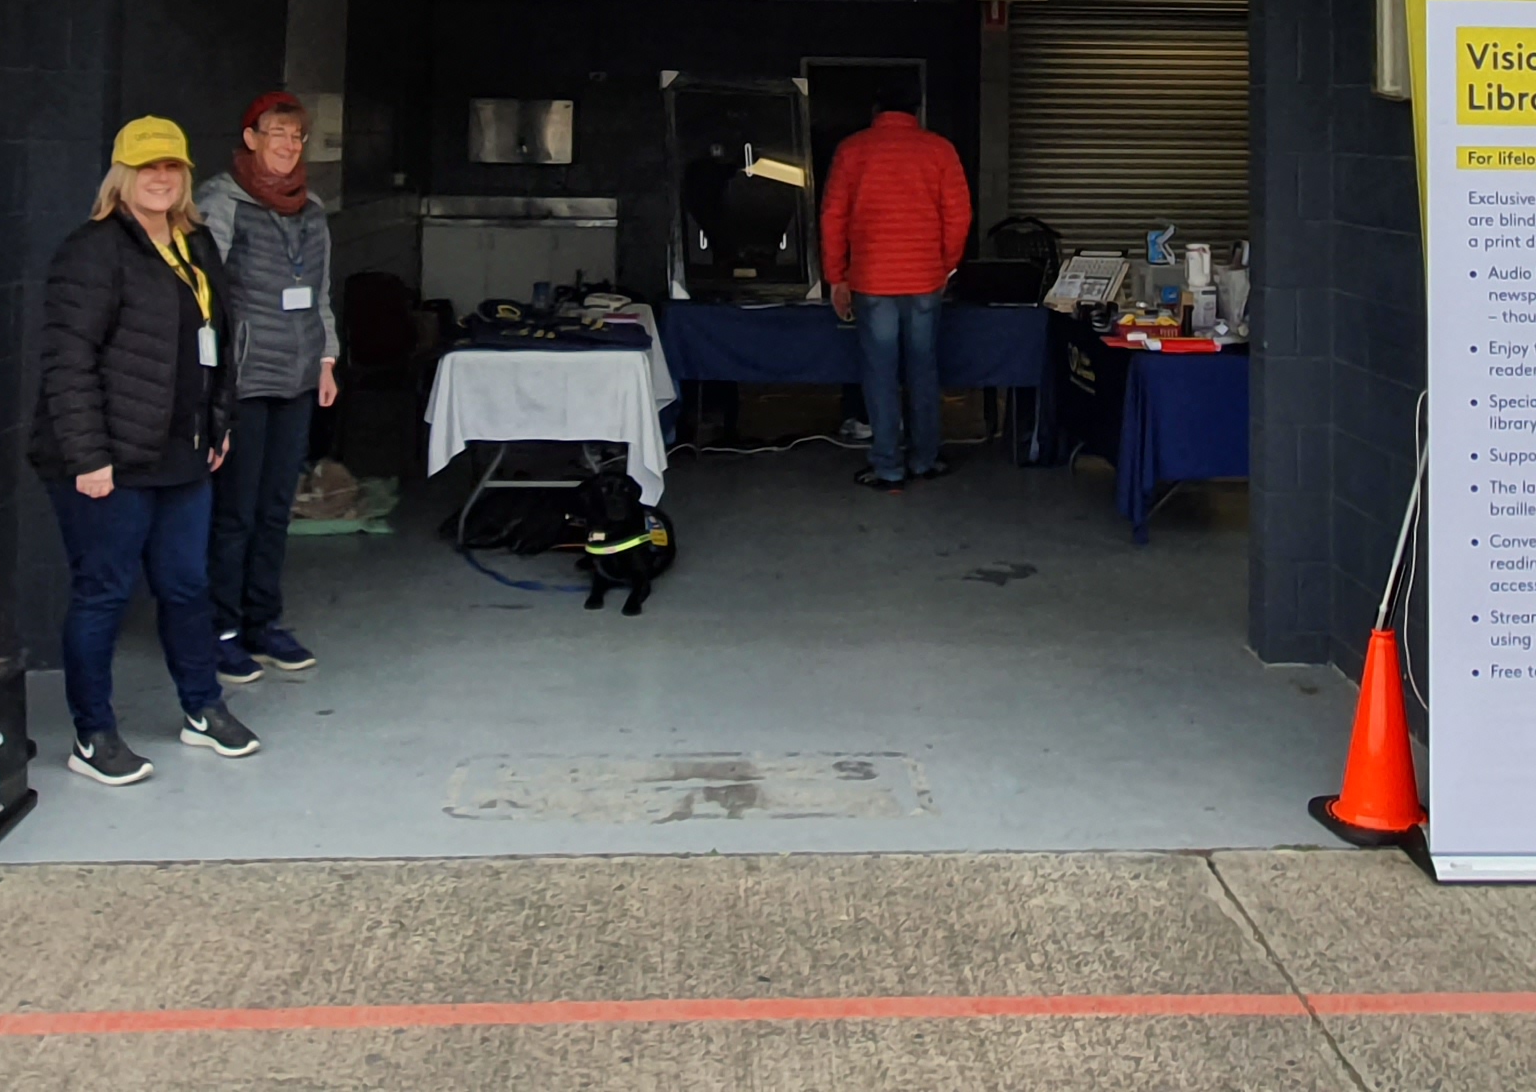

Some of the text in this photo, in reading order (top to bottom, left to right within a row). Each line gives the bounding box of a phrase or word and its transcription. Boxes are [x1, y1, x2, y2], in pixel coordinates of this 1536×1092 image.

[1467, 151, 1493, 165] For
[1467, 217, 1494, 227] are
[1468, 238, 1479, 248] a
[1484, 235, 1521, 252] print
[1487, 266, 1532, 280] Audio
[1489, 341, 1529, 359] Enjoy
[1489, 480, 1517, 495] The
[1489, 502, 1536, 516] braille
[1490, 632, 1532, 651] using
[1490, 664, 1523, 679] Free
